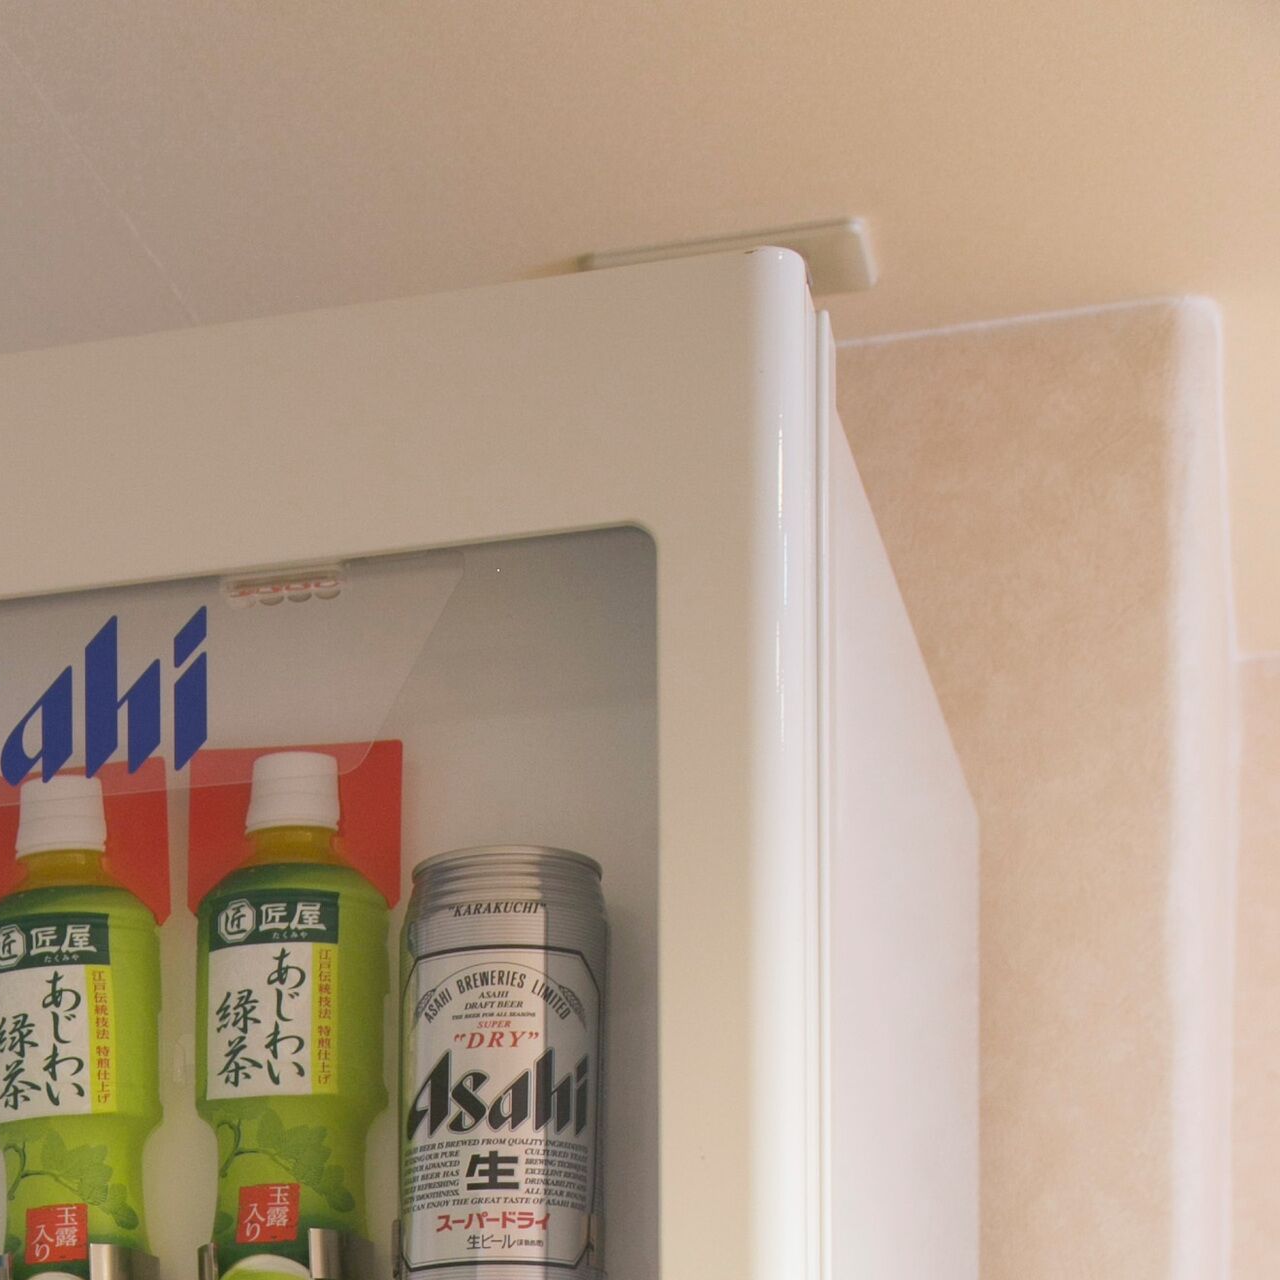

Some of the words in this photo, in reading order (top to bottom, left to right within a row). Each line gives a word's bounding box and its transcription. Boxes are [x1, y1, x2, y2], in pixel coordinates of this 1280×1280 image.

[224, 903, 248, 937] 匠
[258, 902, 328, 931] 匠屋
[29, 923, 97, 956] 匠屋
[424, 987, 453, 1025] ASAHI
[456, 970, 527, 995] BREWERIES
[531, 978, 572, 1021] LIMITED
[464, 1000, 494, 1010] DRAFT
[496, 1000, 524, 1008] BEER
[478, 990, 509, 999] ASAHI
[264, 946, 307, 1086] あじわい
[477, 1020, 512, 1029] SUPER
[42, 970, 85, 1106] あじわい
[215, 988, 264, 1088] 緑茶
[407, 1047, 589, 1141] Asahi
[445, 1138, 480, 1150] BREWED
[481, 1137, 505, 1146] FROM
[508, 1138, 543, 1147] QUALITY
[465, 1150, 519, 1191] 生
[266, 1185, 291, 1228] 玉露
[426, 1199, 450, 1209] ENJOY
[452, 1197, 470, 1206] THE
[470, 1196, 500, 1206] GREAT
[502, 1196, 531, 1205] TASTE
[55, 1206, 79, 1248] 玉露
[244, 1203, 266, 1241] 入り
[436, 1211, 551, 1233] スーパードライ
[33, 1224, 55, 1262] 入り
[466, 1233, 516, 1251] 生ビール
